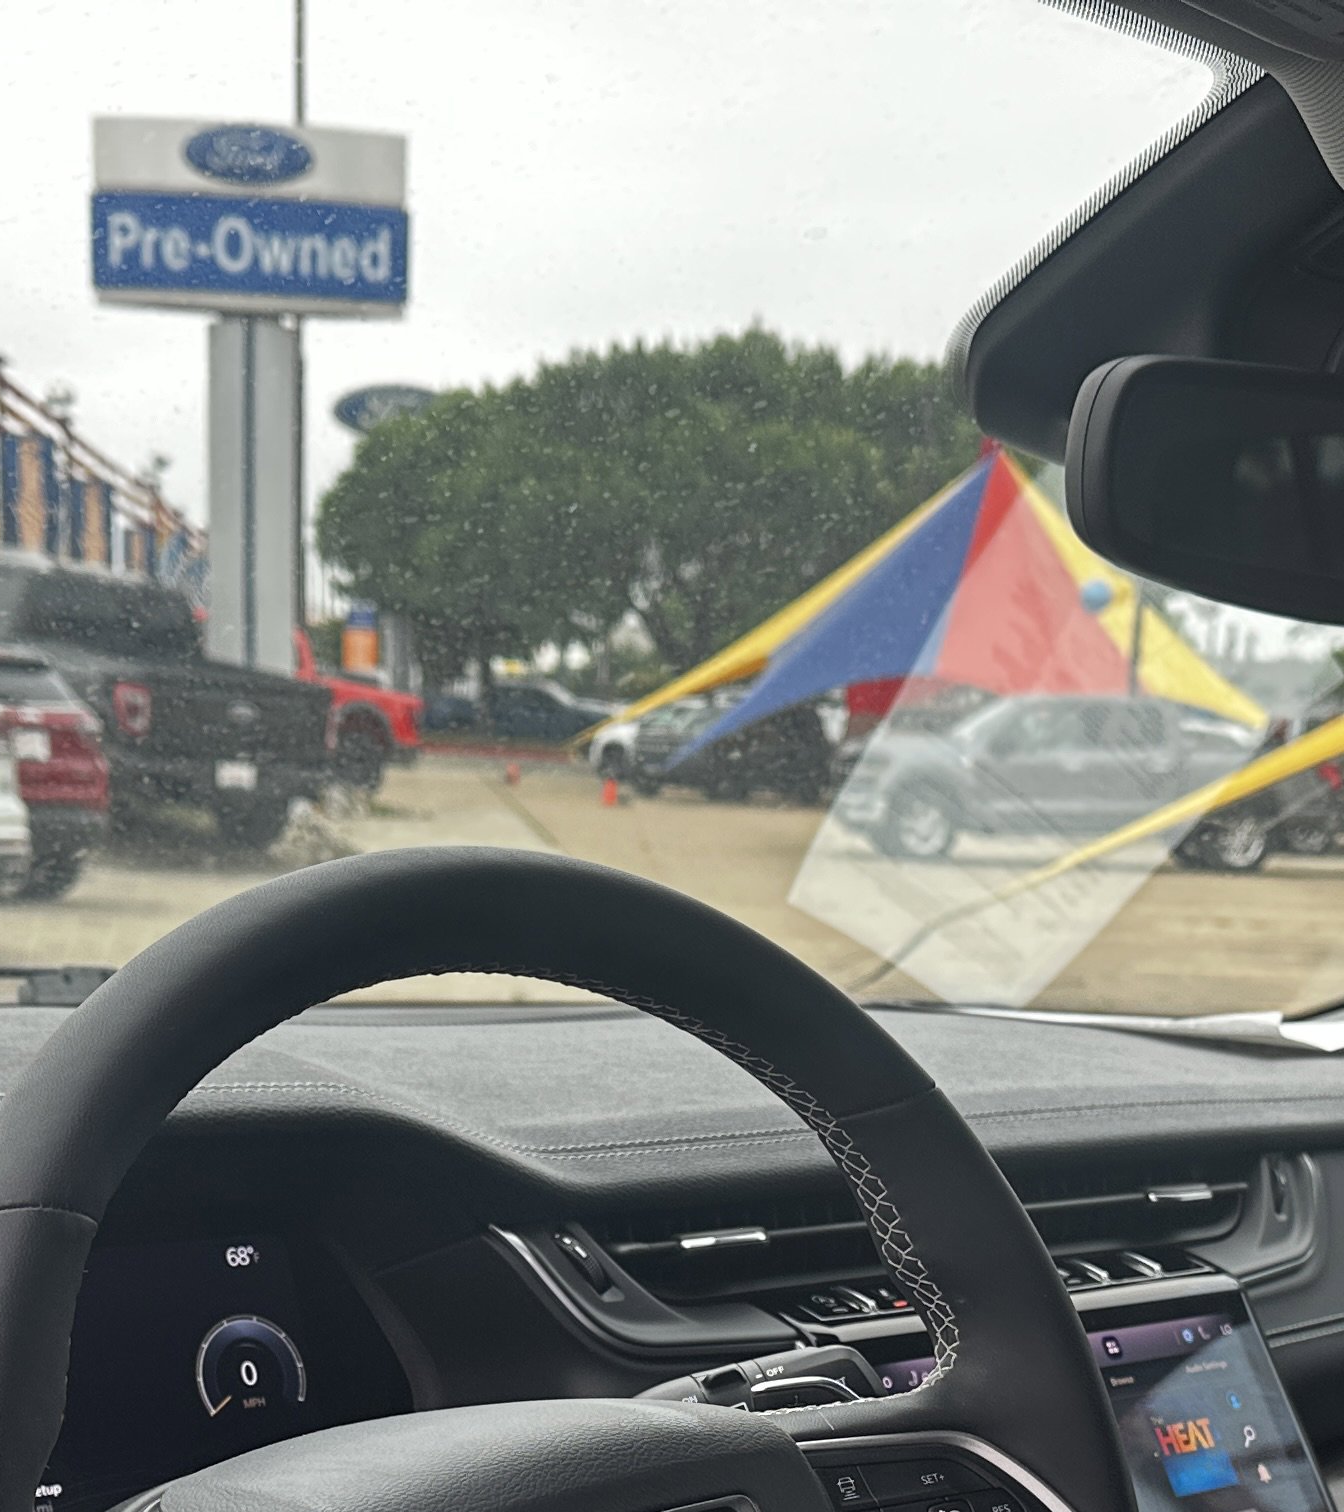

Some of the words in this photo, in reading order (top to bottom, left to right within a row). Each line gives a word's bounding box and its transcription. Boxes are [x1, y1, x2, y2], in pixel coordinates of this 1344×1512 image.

[107, 211, 393, 282] Pre-Owned
[240, 1360, 258, 1386] 0
[766, 1365, 785, 1378] OFF
[1154, 1417, 1216, 1457] HEAT
[920, 1472, 945, 1485] SET+
[35, 1484, 63, 1498] etup
